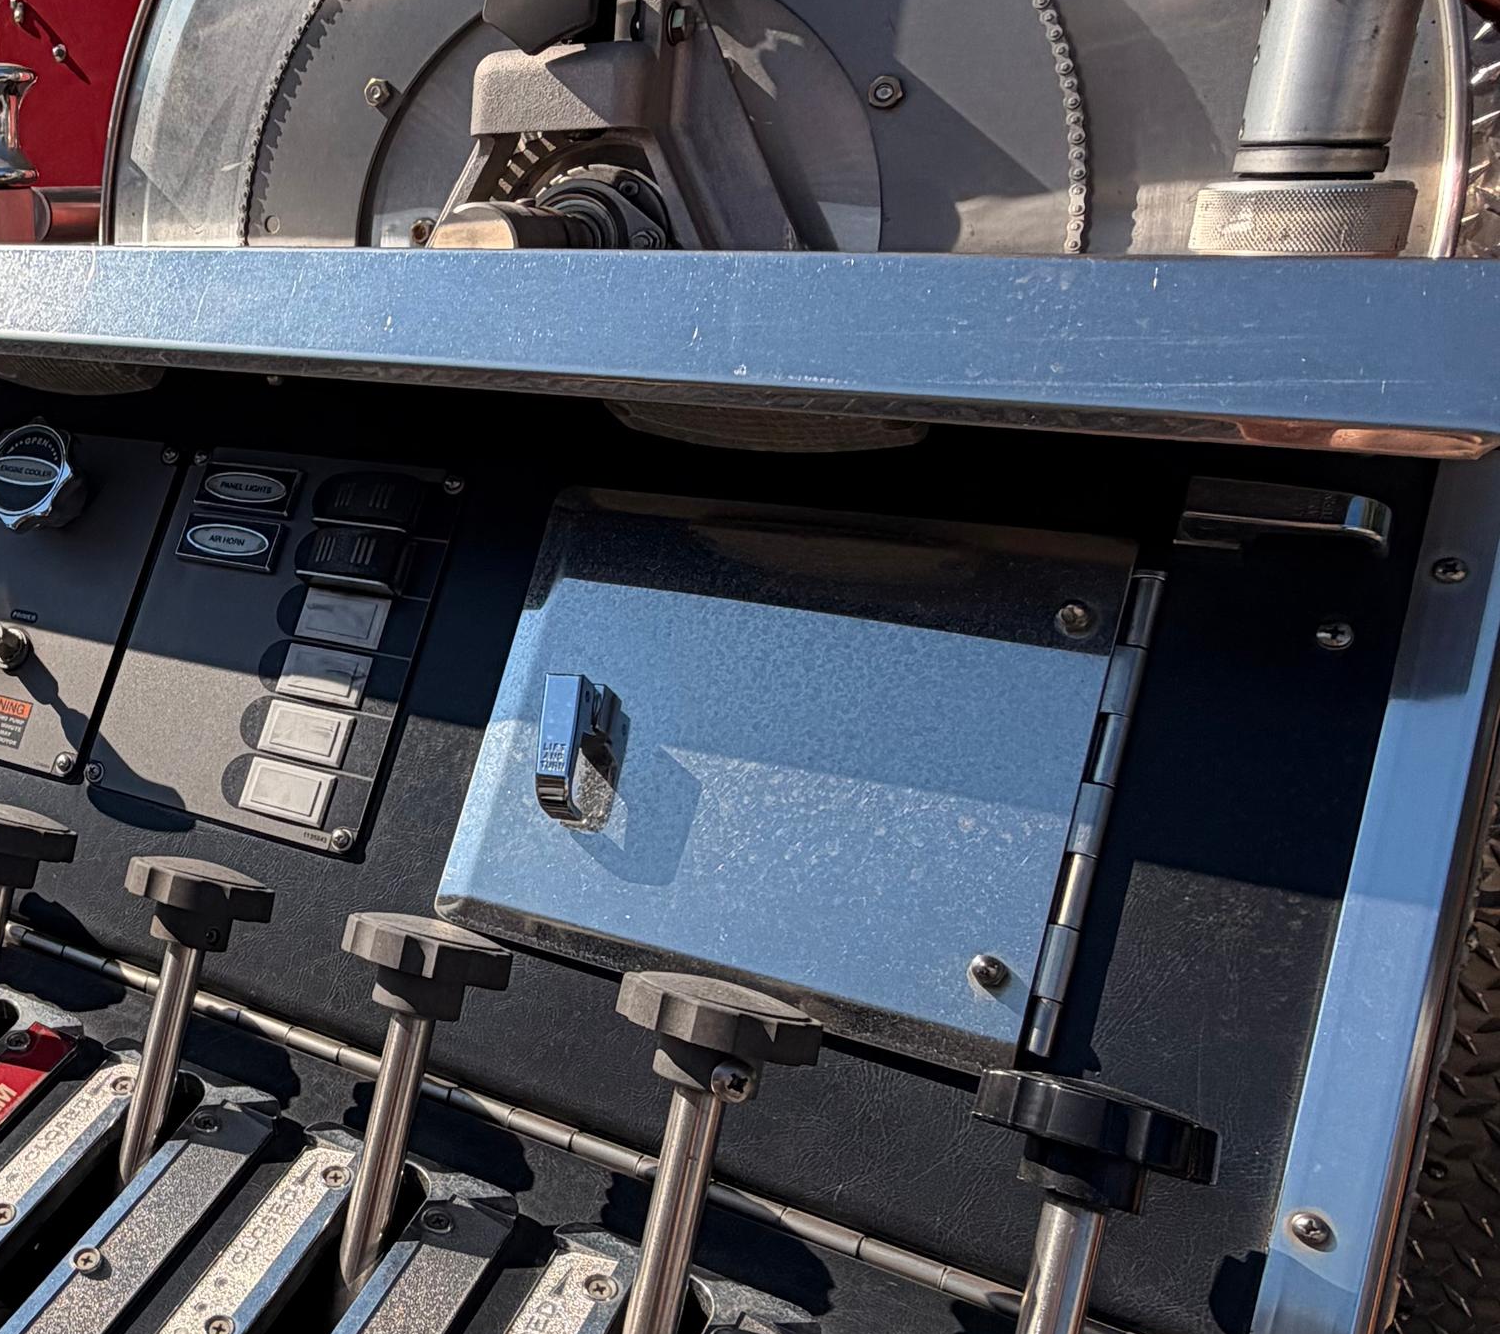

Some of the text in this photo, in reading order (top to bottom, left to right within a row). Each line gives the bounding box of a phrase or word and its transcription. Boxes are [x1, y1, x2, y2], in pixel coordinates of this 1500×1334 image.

[24, 435, 51, 448] OPEN
[220, 481, 273, 494] PANEL LIGHTS
[209, 534, 246, 546] AIR HORN
[232, 1187, 301, 1266] CLOSED
